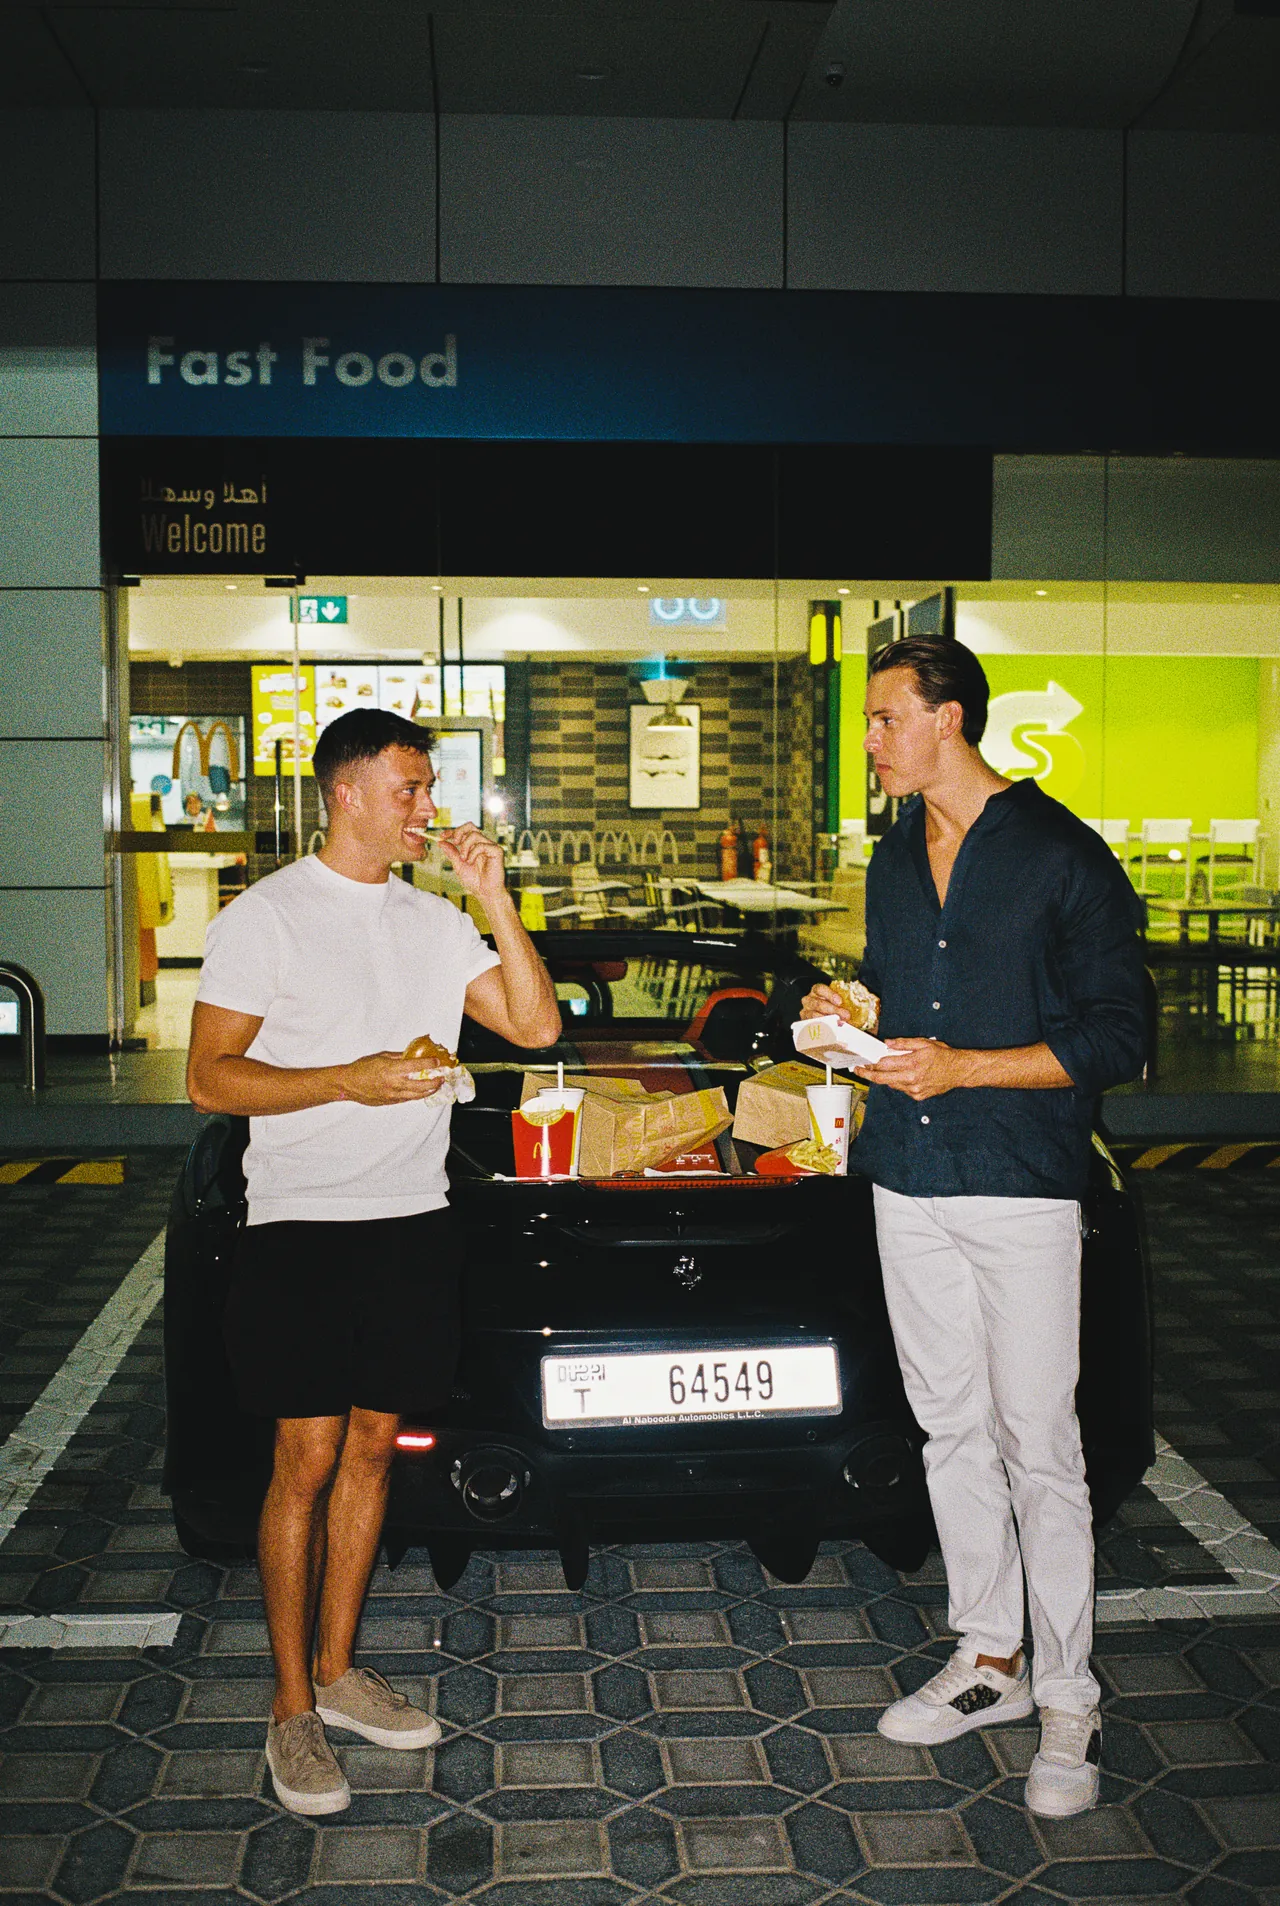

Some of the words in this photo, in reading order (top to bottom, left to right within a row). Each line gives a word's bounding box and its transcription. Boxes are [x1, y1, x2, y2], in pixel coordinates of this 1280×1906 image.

[147, 335, 278, 386] Fast
[302, 333, 458, 387] Food
[141, 513, 267, 554] Welcome
[573, 1387, 591, 1414] T
[668, 1360, 774, 1405] 64549
[622, 1416, 632, 1425] Al
[634, 1414, 676, 1424] Nabooda
[678, 1411, 735, 1423] Automobiles
[737, 1409, 764, 1419] L.L.C.
